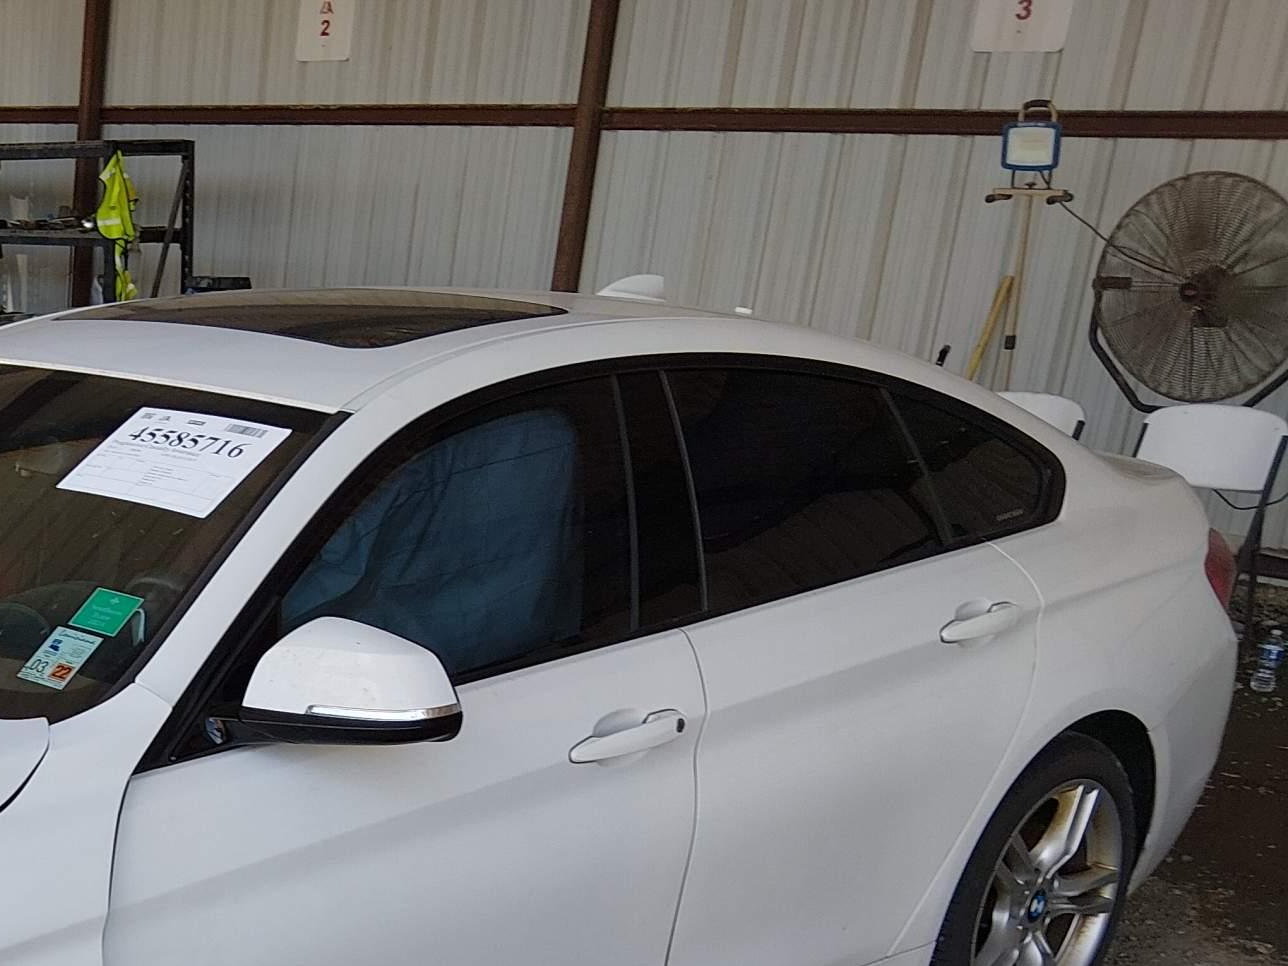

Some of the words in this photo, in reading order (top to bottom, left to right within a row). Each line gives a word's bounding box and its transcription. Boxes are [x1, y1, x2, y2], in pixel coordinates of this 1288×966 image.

[1015, 0, 1033, 21] 3
[320, 19, 331, 37] 2
[128, 426, 254, 459] 45585716
[30, 659, 49, 673] 03
[51, 664, 73, 679] 22
